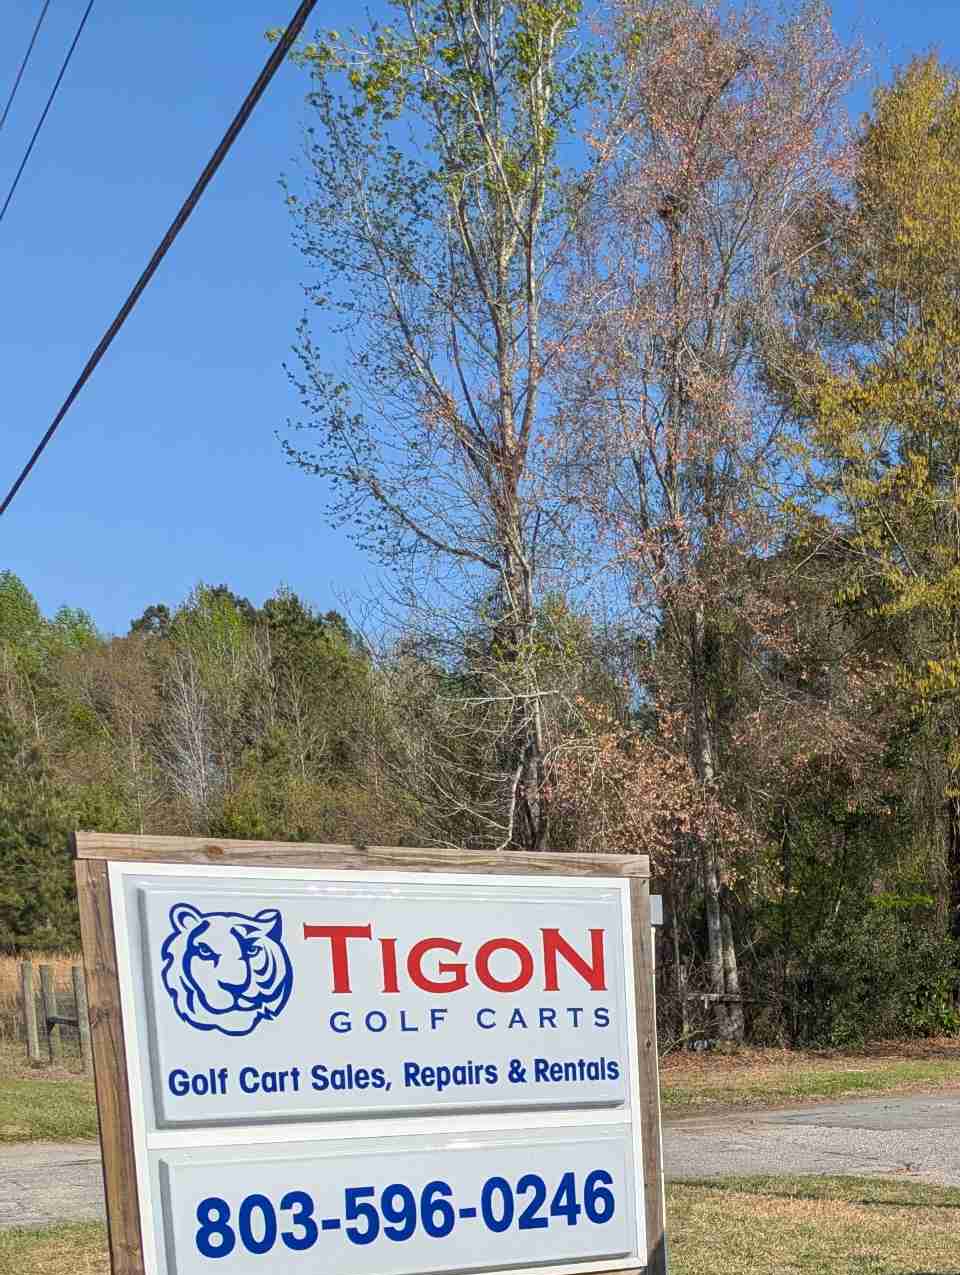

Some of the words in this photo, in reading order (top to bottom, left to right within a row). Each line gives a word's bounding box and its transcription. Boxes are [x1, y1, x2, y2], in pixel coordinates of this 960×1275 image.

[303, 923, 607, 994] TIGON
[329, 1009, 447, 1034] GOLF
[476, 1007, 611, 1029] CARTS
[168, 1067, 229, 1097] Golf
[240, 1065, 301, 1094] Cart
[311, 1063, 393, 1092] Sales,
[403, 1061, 499, 1092] Repairs
[508, 1059, 528, 1084] &
[534, 1057, 621, 1084] Rentals
[195, 1169, 616, 1259] 803-596-0246
